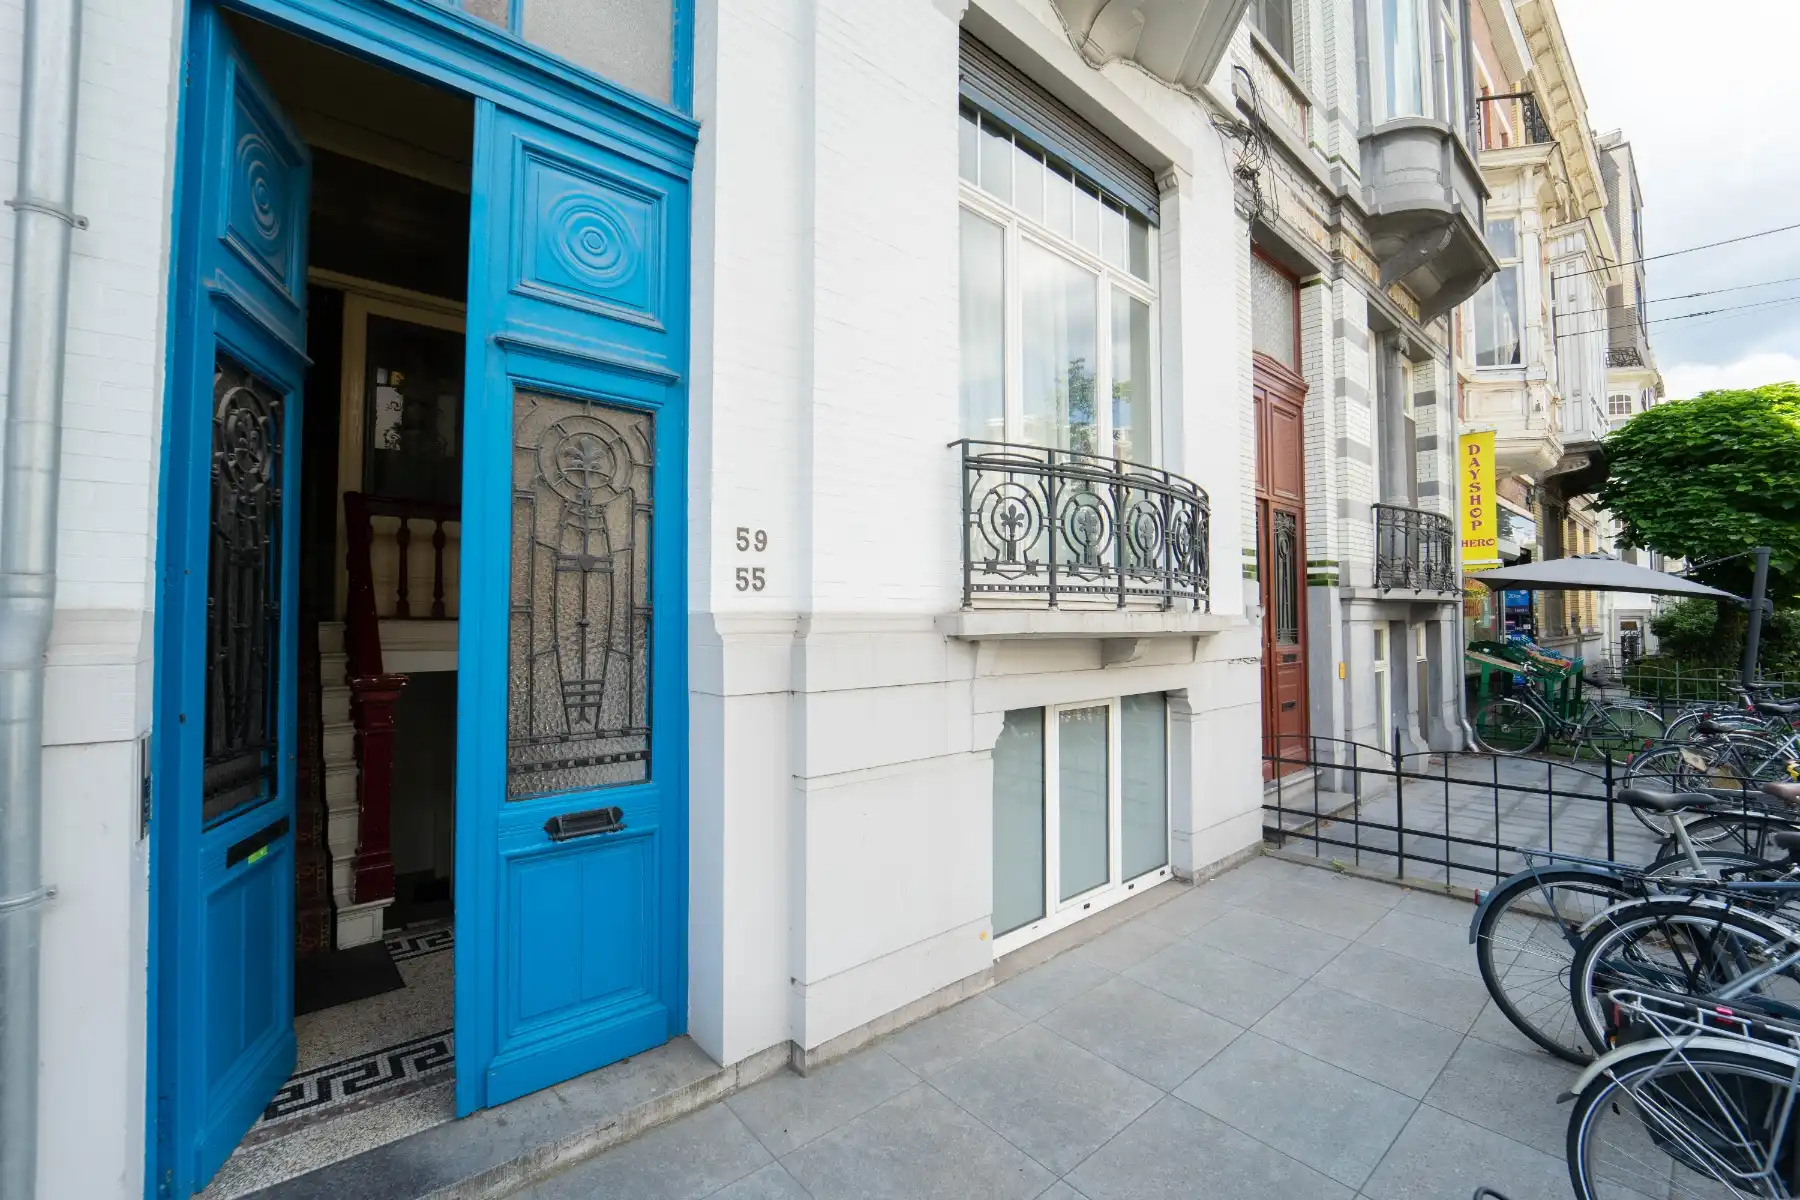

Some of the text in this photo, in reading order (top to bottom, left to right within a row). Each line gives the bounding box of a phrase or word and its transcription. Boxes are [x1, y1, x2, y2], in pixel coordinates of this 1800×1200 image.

[1468, 444, 1482, 531] DAYSHOP
[736, 527, 768, 552] 59
[735, 567, 766, 592] 55
